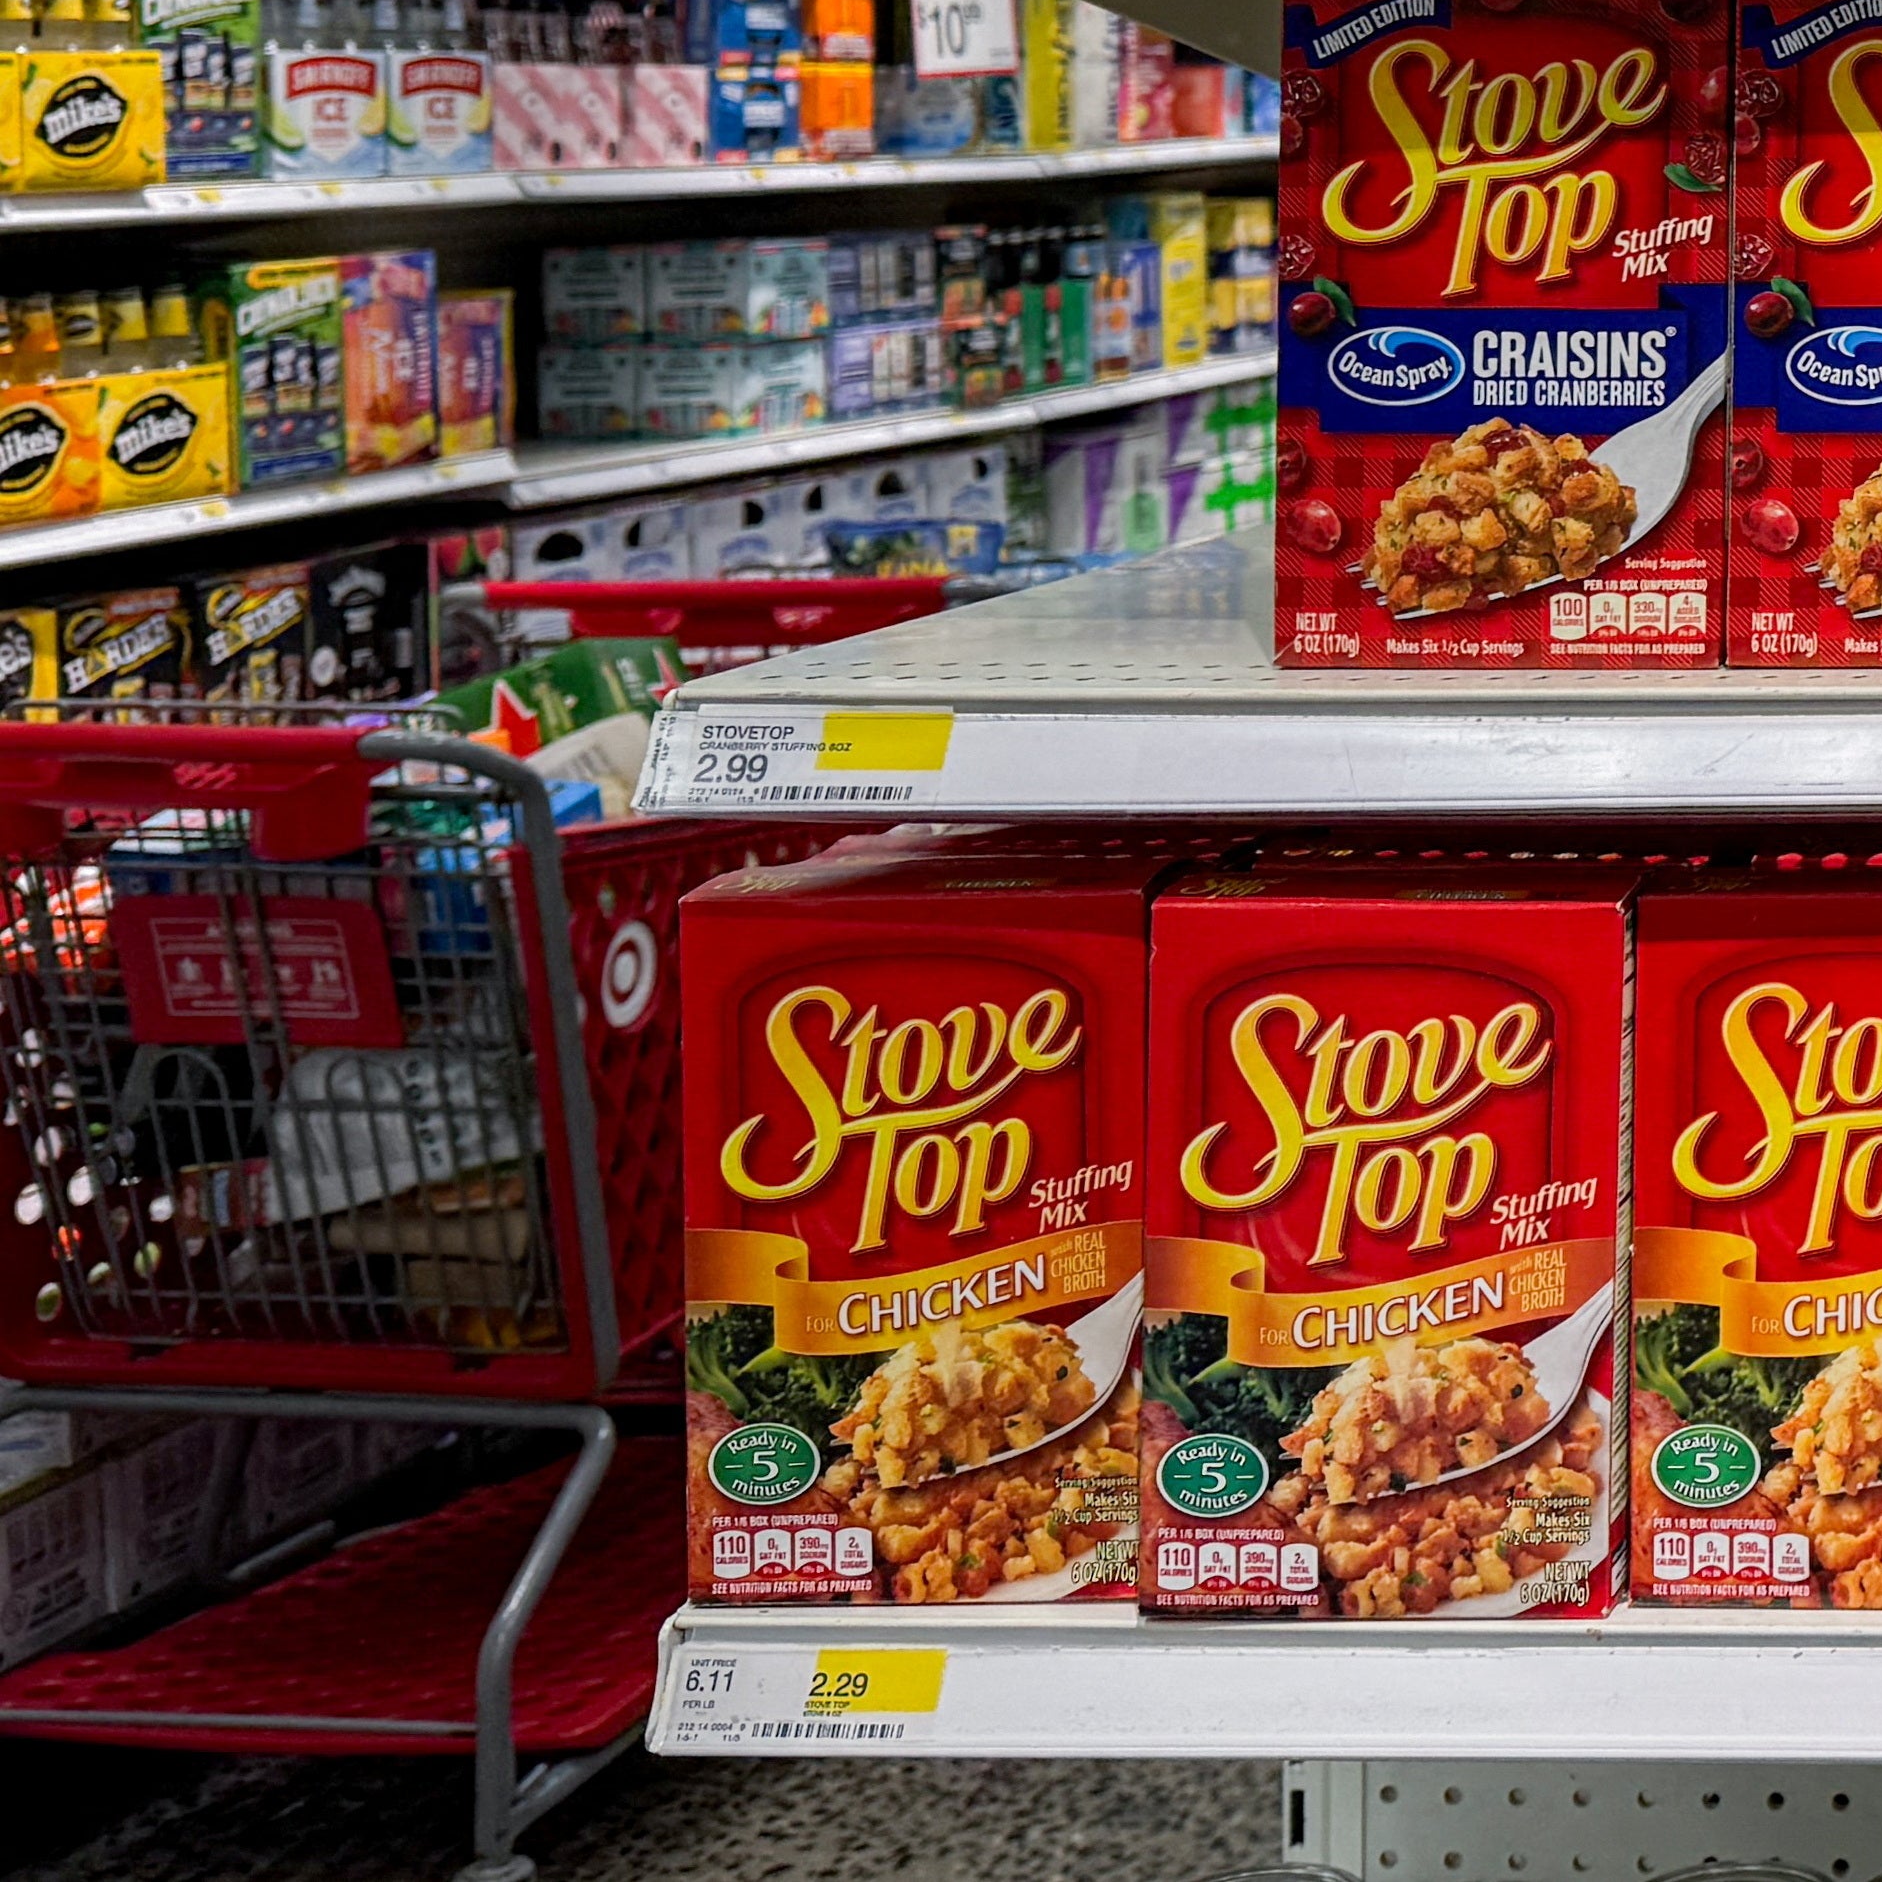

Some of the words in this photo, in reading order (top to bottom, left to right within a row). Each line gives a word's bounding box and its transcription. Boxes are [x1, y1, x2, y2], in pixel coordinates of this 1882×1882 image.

[1313, 16, 1374, 60] LIMITED
[1322, 39, 1668, 245] Stove
[1435, 165, 1617, 298] Top
[1612, 214, 1713, 258] Stuffing
[1621, 251, 1669, 283] Mix
[1473, 330, 1666, 379] CRAISINS
[1339, 351, 1394, 386] Ocean
[1473, 380, 1527, 406] DRIED
[1534, 380, 1665, 406] CRANBERRIES
[1554, 597, 1582, 617] 100
[1295, 613, 1316, 632] NET
[1318, 613, 1337, 632] WT
[1293, 634, 1302, 653] 6
[1304, 634, 1322, 653] OZ
[1323, 634, 1360, 658] (170g)
[1386, 640, 1419, 654] Makes
[1421, 640, 1439, 654] Six
[1460, 641, 1479, 657] Cup
[1482, 640, 1524, 657] Servings
[699, 742, 769, 751] CRANBERRY
[702, 726, 794, 740] STOVETOP
[693, 754, 768, 783] 2.99
[720, 984, 1083, 1203] Stove
[837, 1112, 1032, 1256] Top
[1029, 1161, 1133, 1208] Stuffing
[1039, 1201, 1088, 1233] Mix
[1074, 1231, 1106, 1252] REAL
[1051, 1251, 1106, 1278] CHICKEN
[838, 1254, 1045, 1335] CHICKEN
[1063, 1271, 1106, 1294] BROTH
[1292, 1271, 1505, 1350] CHICKEN
[727, 1434, 777, 1455] Ready
[781, 1437, 797, 1453] in
[753, 1450, 779, 1482] 5
[732, 1476, 800, 1495] minutes
[717, 1535, 746, 1555] 110
[691, 1659, 711, 1667] UNIT
[712, 1659, 736, 1667] PRICE
[686, 1670, 734, 1692] 6.11
[809, 1673, 868, 1697] 2.29
